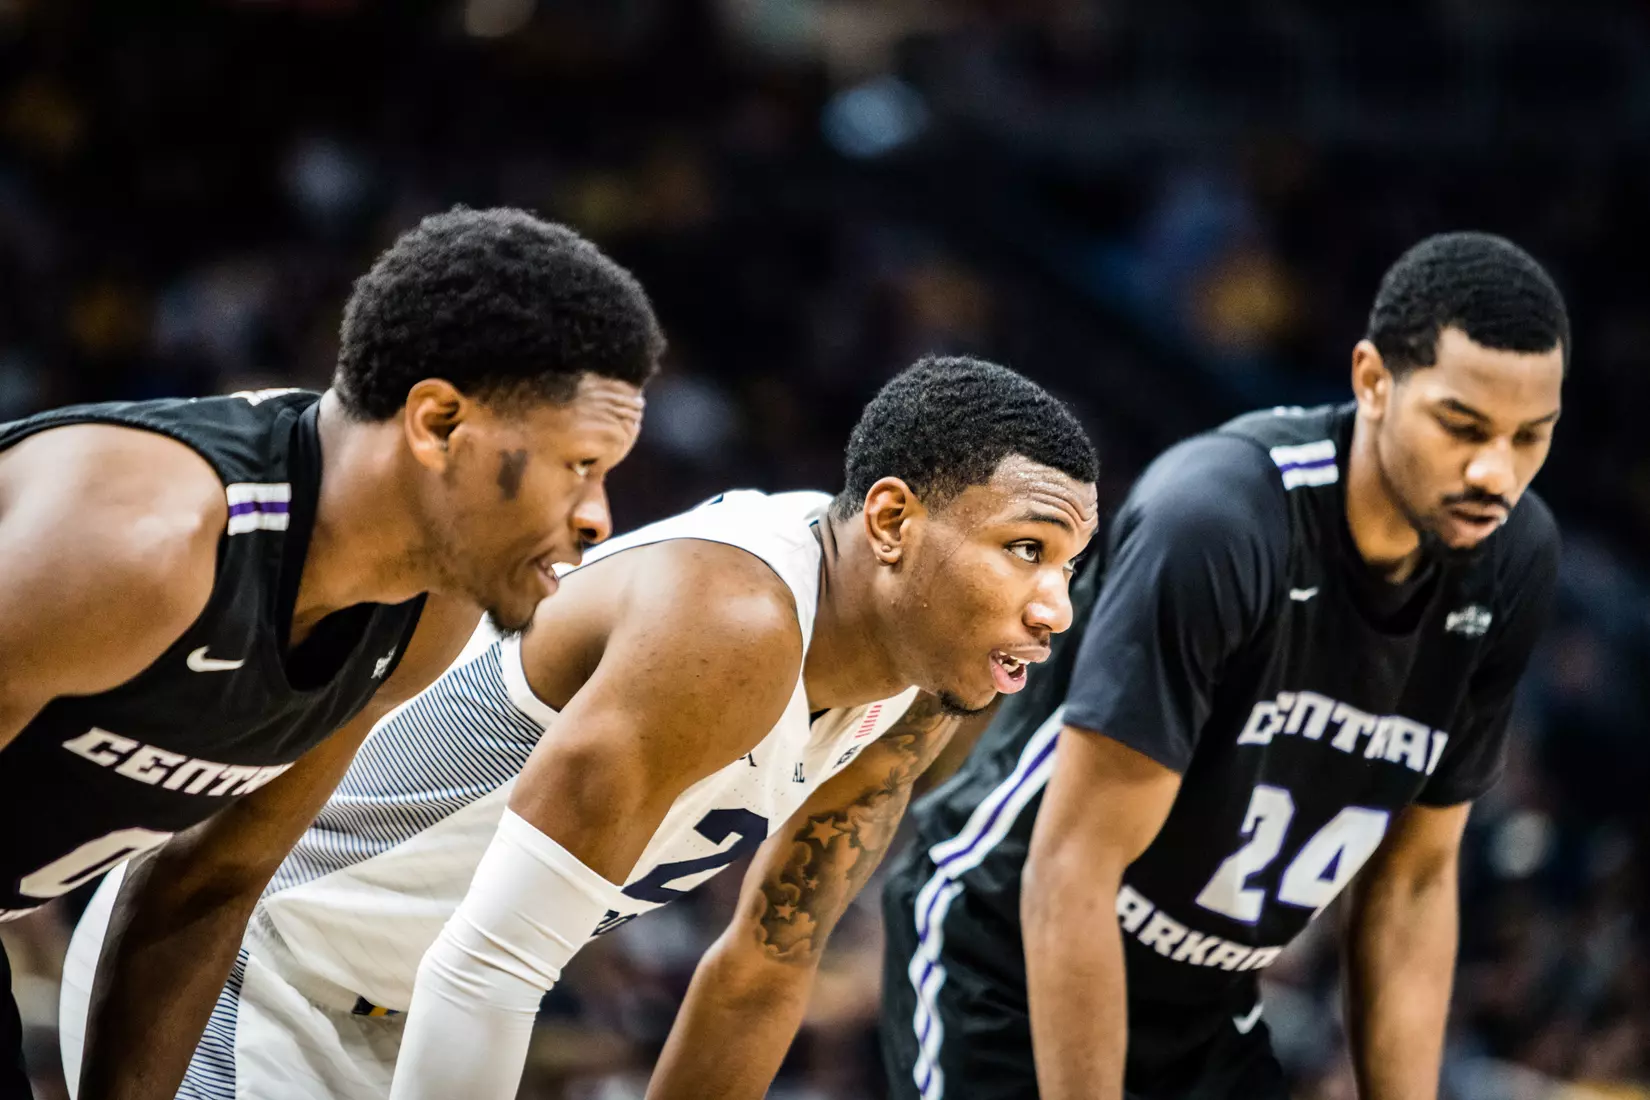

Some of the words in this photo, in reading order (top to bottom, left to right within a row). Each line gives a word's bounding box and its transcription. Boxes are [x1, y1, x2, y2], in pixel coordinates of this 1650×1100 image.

[61, 726, 296, 797] CENTR
[19, 826, 174, 899] 0
[620, 808, 768, 903] 2
[1195, 784, 1391, 925] 24
[1115, 884, 1285, 972] ARKAN
